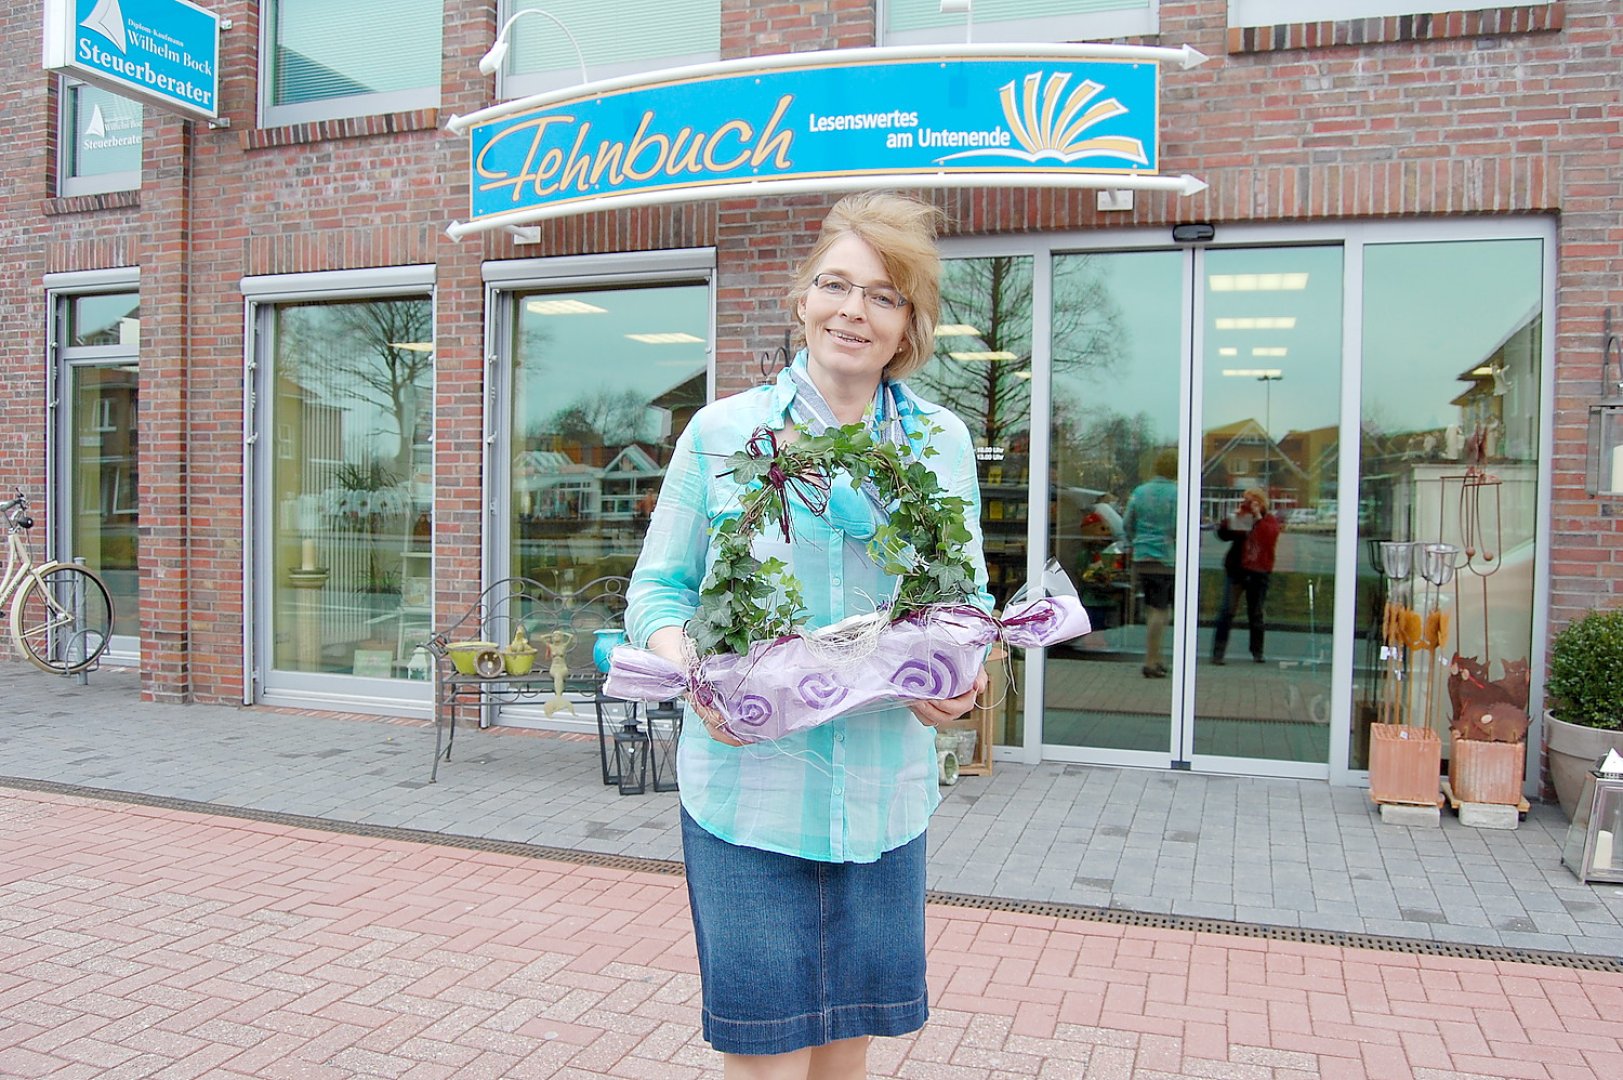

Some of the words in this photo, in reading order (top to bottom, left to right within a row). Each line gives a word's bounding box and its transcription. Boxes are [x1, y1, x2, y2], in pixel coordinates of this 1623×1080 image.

[128, 29, 180, 63] Wilhelm
[183, 53, 212, 77] Bock
[79, 38, 212, 105] Steuerberater
[809, 110, 918, 132] Lesenswertes
[886, 131, 913, 148] am
[917, 126, 1011, 147] Untenende
[84, 135, 142, 150] Steuerberate
[476, 94, 795, 202] Fehnbuch
